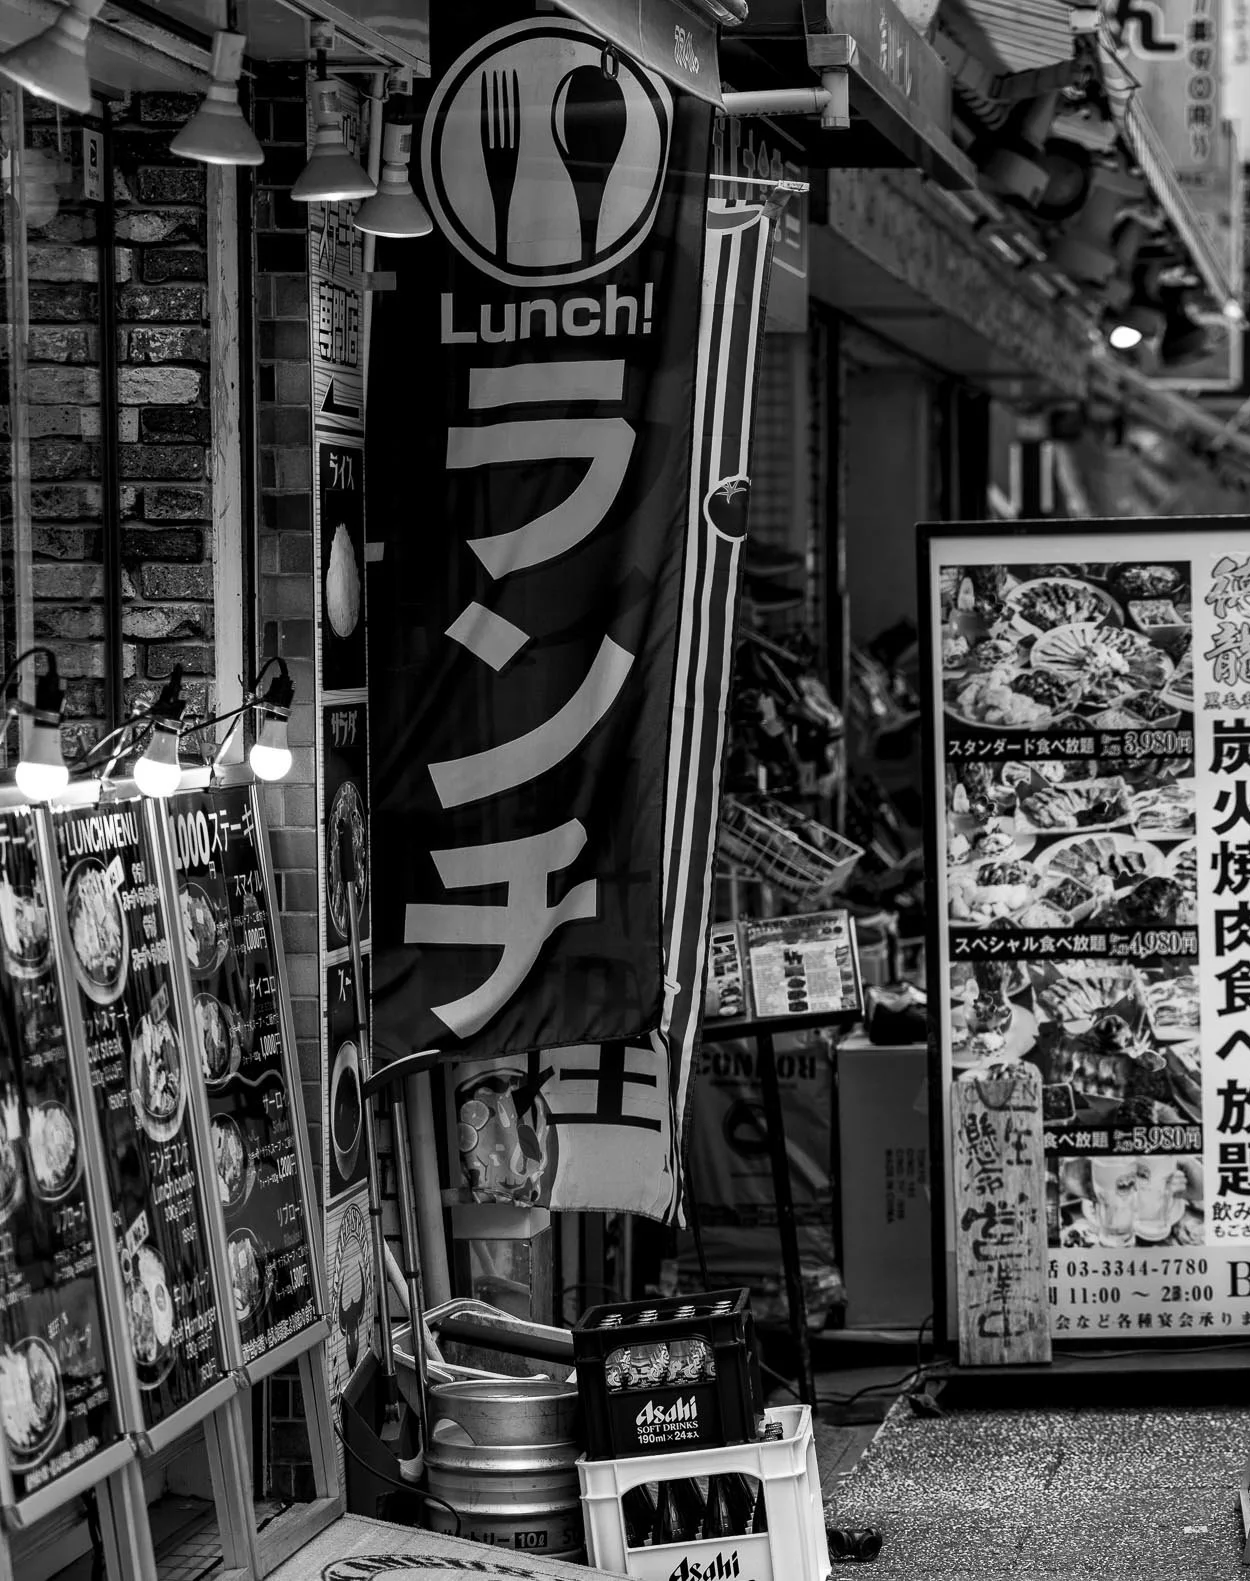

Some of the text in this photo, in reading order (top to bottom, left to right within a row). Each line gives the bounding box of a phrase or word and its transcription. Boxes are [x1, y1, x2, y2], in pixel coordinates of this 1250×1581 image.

[440, 282, 654, 345] Lunch!
[405, 359, 636, 1040] ランチ
[949, 736, 1095, 756] スタンダード食べ放題
[1123, 730, 1194, 758] 3,980円
[955, 935, 1107, 954] スペシャル食べ放題
[696, 1050, 816, 1081] CONOR
[1043, 1130, 1109, 1149] 食べ放題
[1066, 1258, 1209, 1278] 03-3344-7780
[1069, 1286, 1121, 1305] 11:00
[635, 1395, 699, 1426] Asahi
[637, 1420, 699, 1435] SOFT DRINKS
[669, 1550, 741, 1581] Asahi
